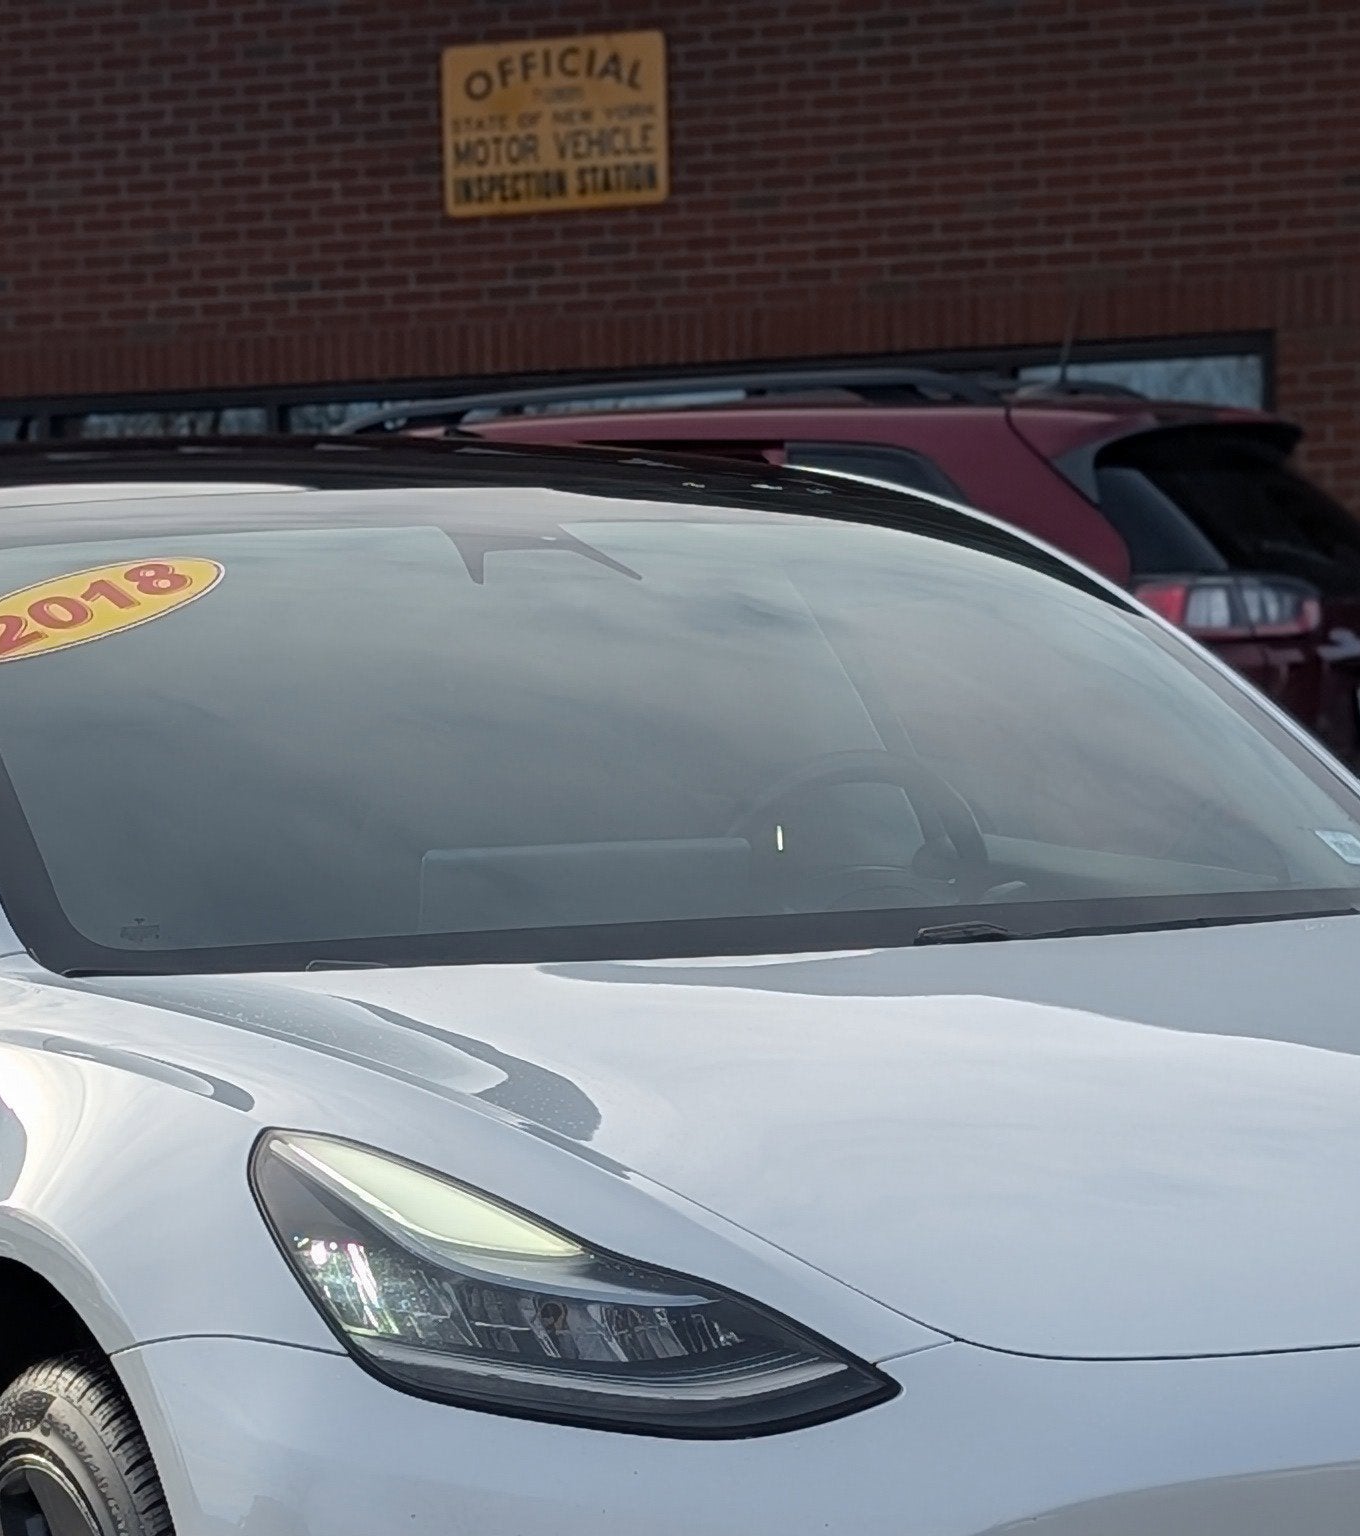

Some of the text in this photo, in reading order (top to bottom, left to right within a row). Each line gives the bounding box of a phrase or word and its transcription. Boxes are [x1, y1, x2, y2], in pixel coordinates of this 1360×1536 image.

[463, 46, 643, 101] OFFICIAL
[452, 123, 655, 168] MOTOR VEHICLE
[452, 161, 658, 205] INSPECTION STATION
